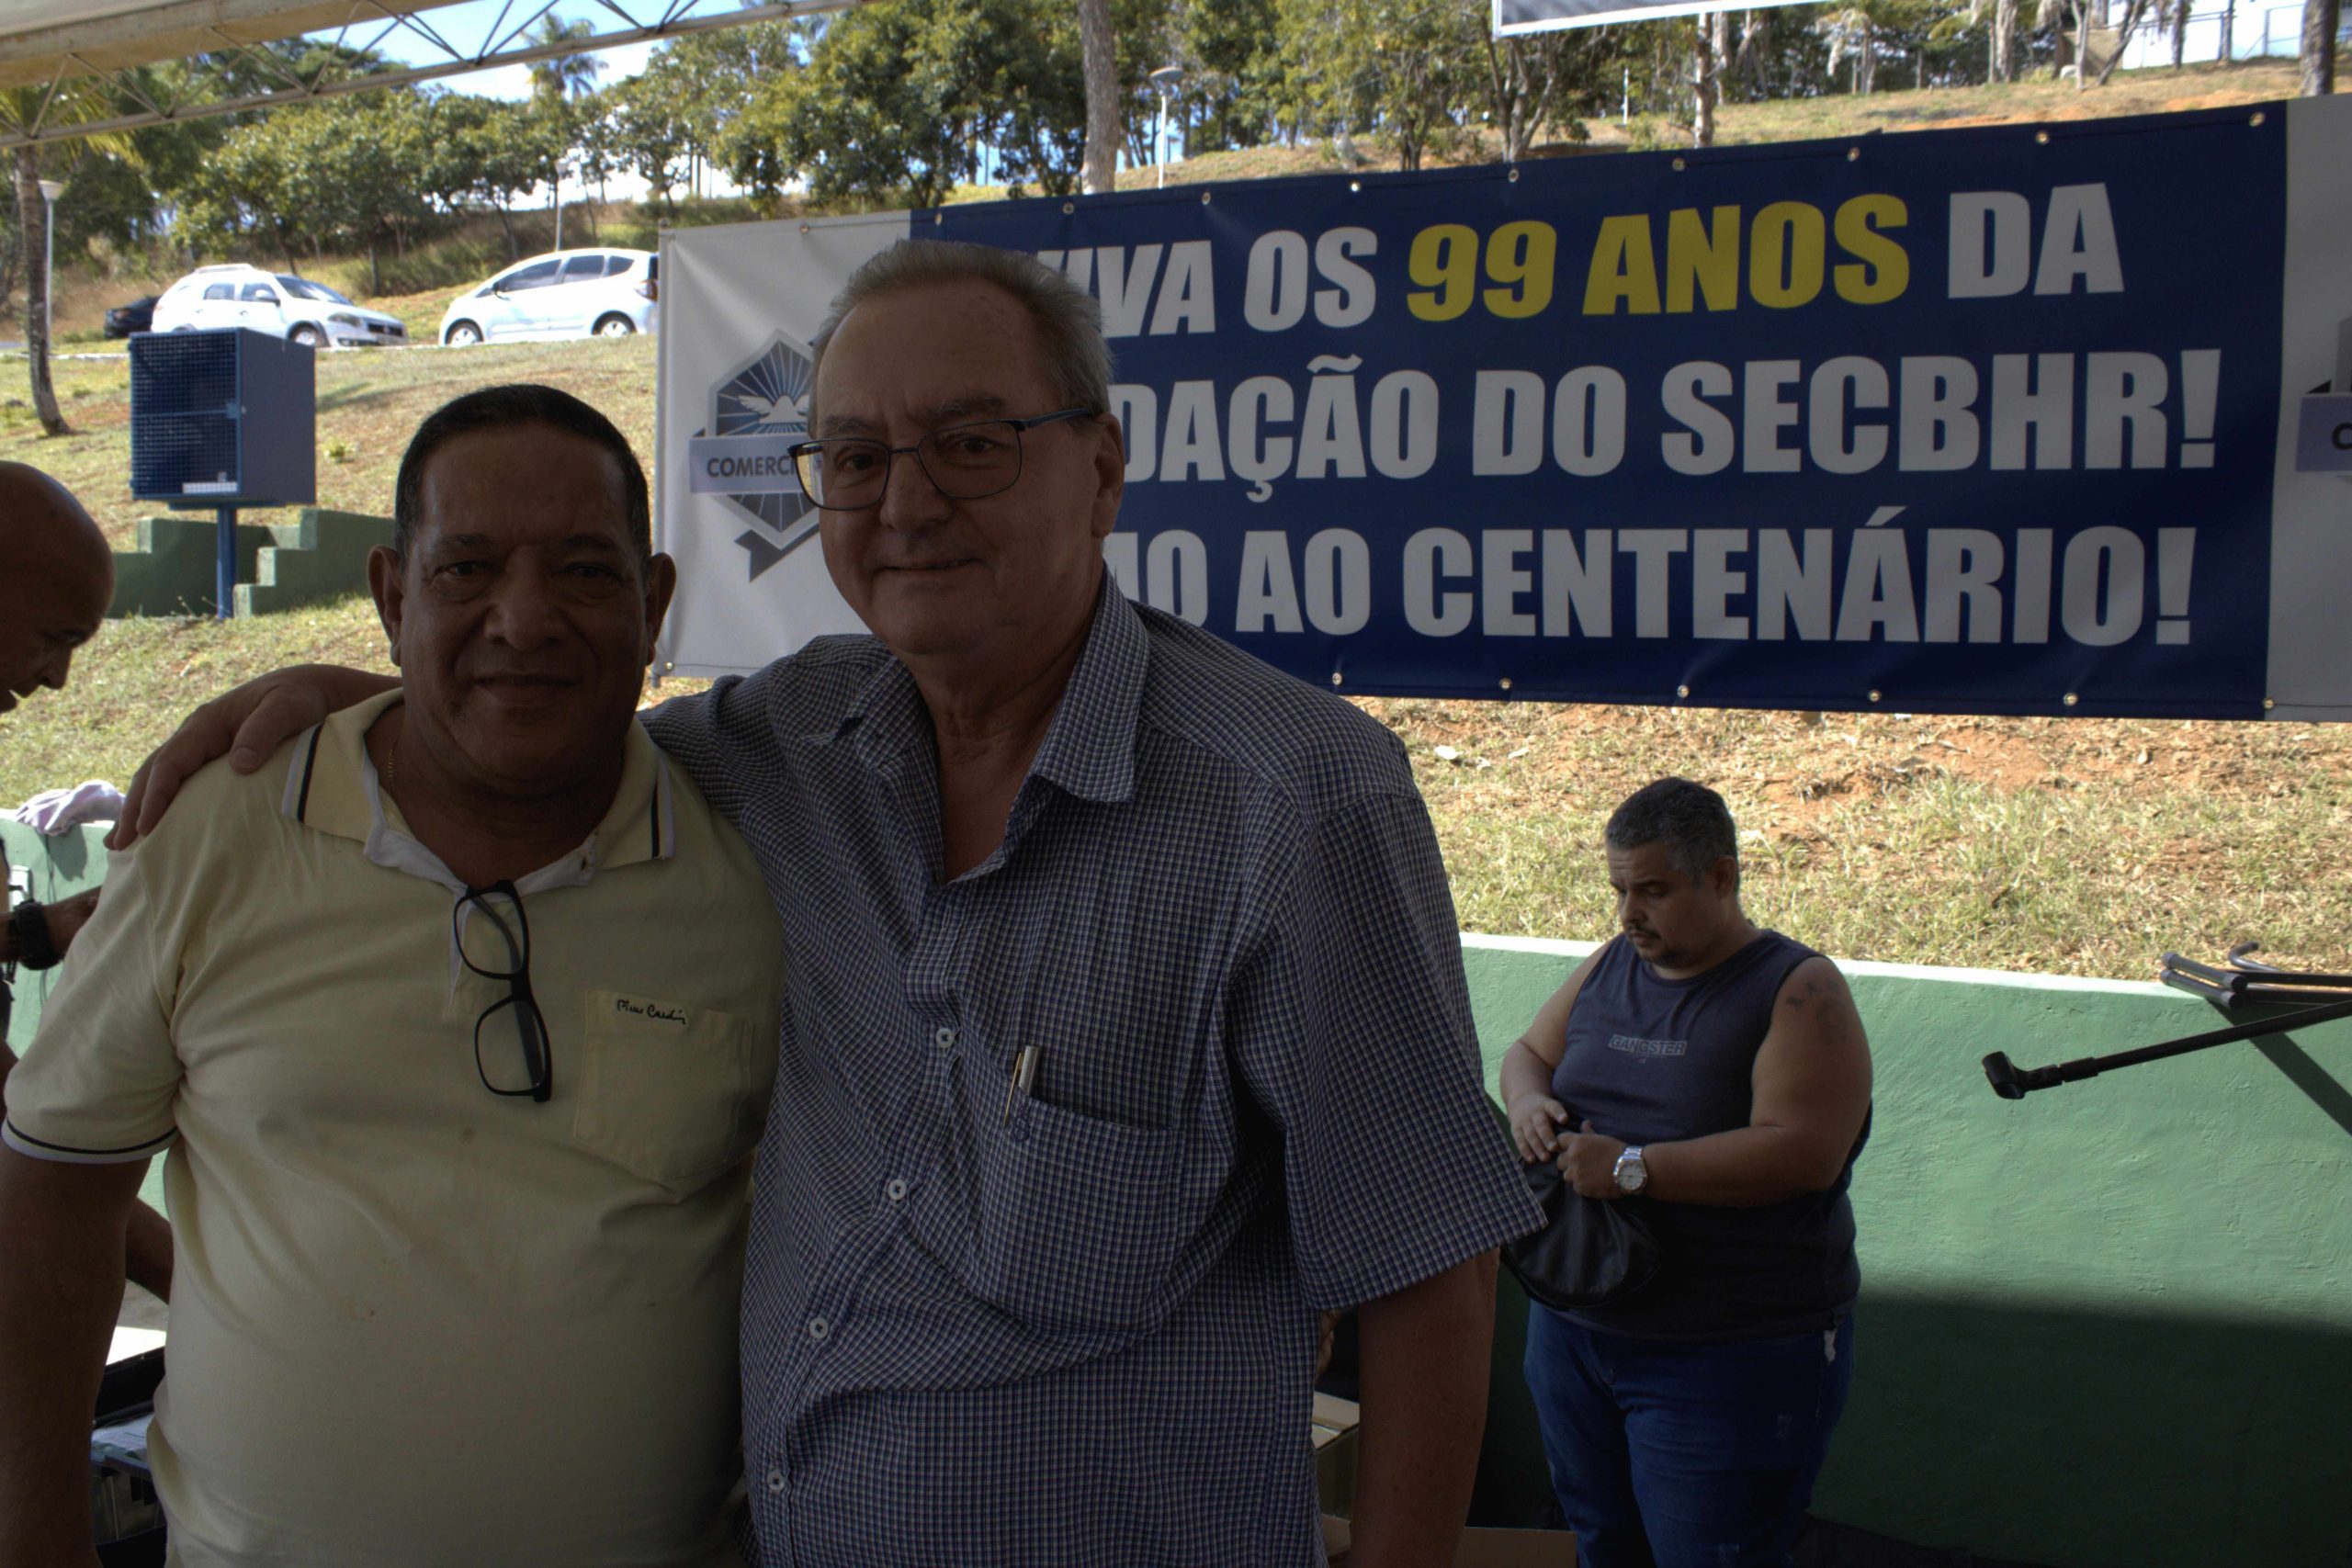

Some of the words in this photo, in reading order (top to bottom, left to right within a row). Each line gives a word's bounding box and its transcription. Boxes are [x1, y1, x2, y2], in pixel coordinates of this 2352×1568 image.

[1037, 240, 1216, 338] VA
[1243, 226, 1378, 332] OS
[1407, 220, 1557, 321] 99
[1582, 194, 1909, 316] ANOS
[1948, 183, 2124, 299] DA
[1473, 366, 1626, 476] DO
[1661, 349, 2222, 476] SECBHR!
[1235, 528, 1371, 636] AO
[1403, 506, 2197, 646] CENTENÁRIO!
[1610, 1035, 1687, 1056] GANGSTER
